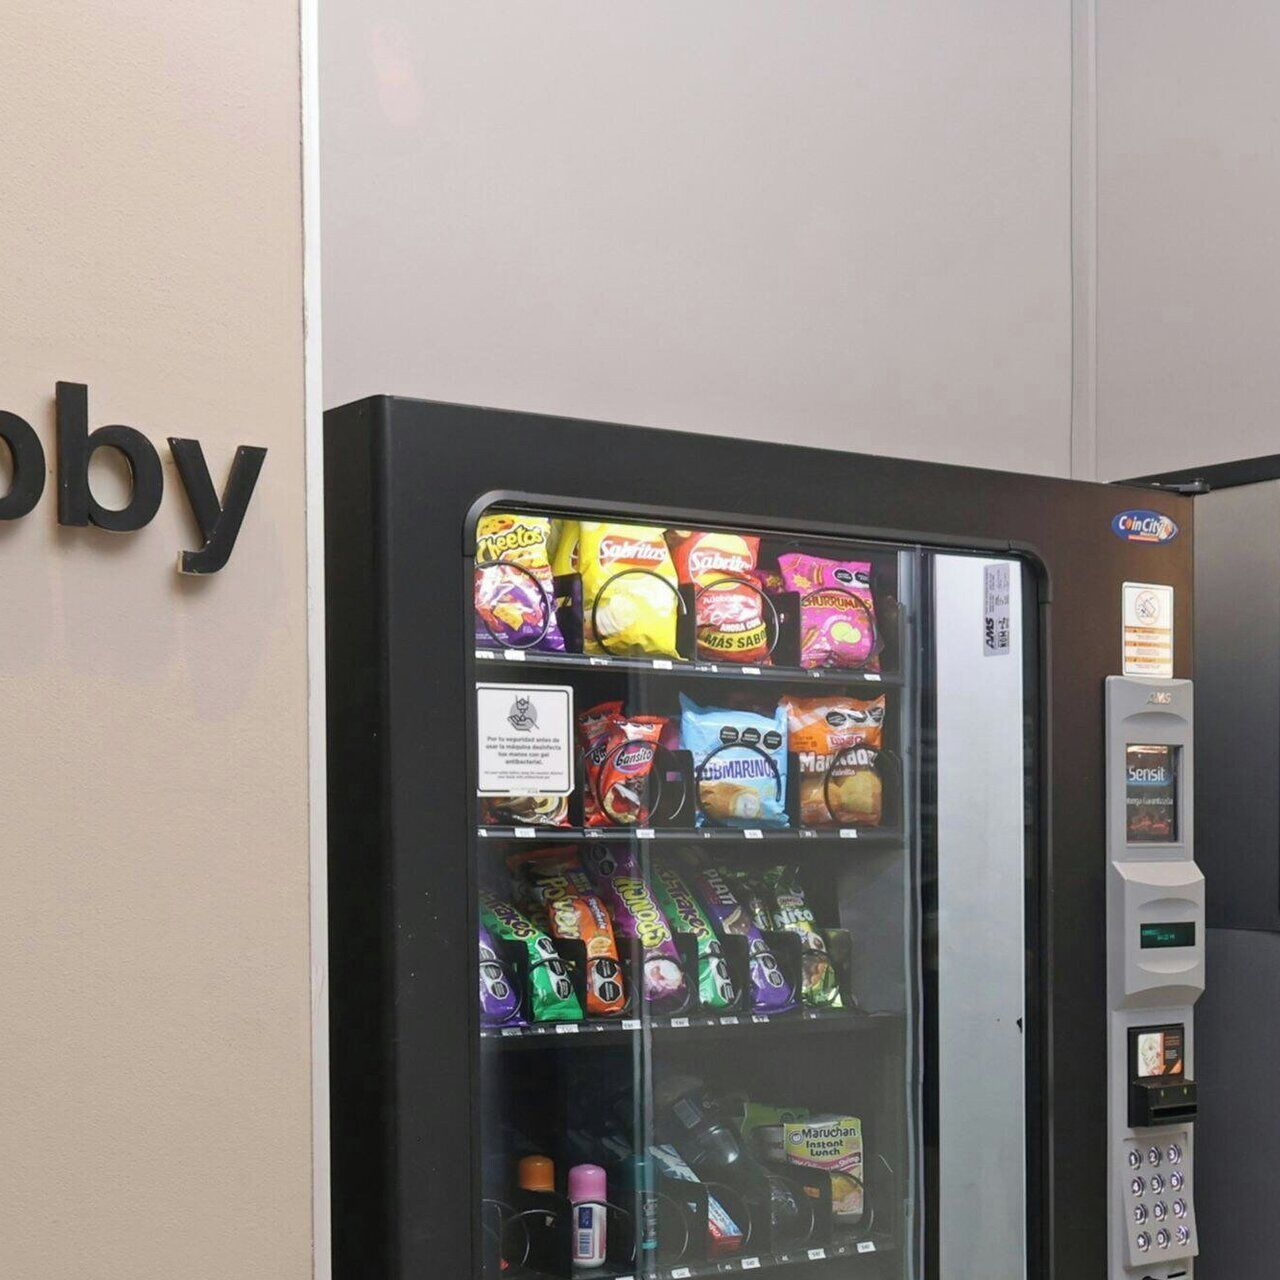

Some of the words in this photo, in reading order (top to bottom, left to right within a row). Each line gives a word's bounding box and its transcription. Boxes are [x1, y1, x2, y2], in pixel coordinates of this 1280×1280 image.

[476, 523, 545, 566] Cheetos
[599, 539, 667, 561] Sabritas
[690, 551, 754, 575] Sabrita
[736, 628, 767, 649] SABO
[616, 747, 653, 767] Gansito
[801, 1126, 857, 1139] Maruchan
[805, 1139, 844, 1149] Instant
[810, 1148, 841, 1157] Lunch
